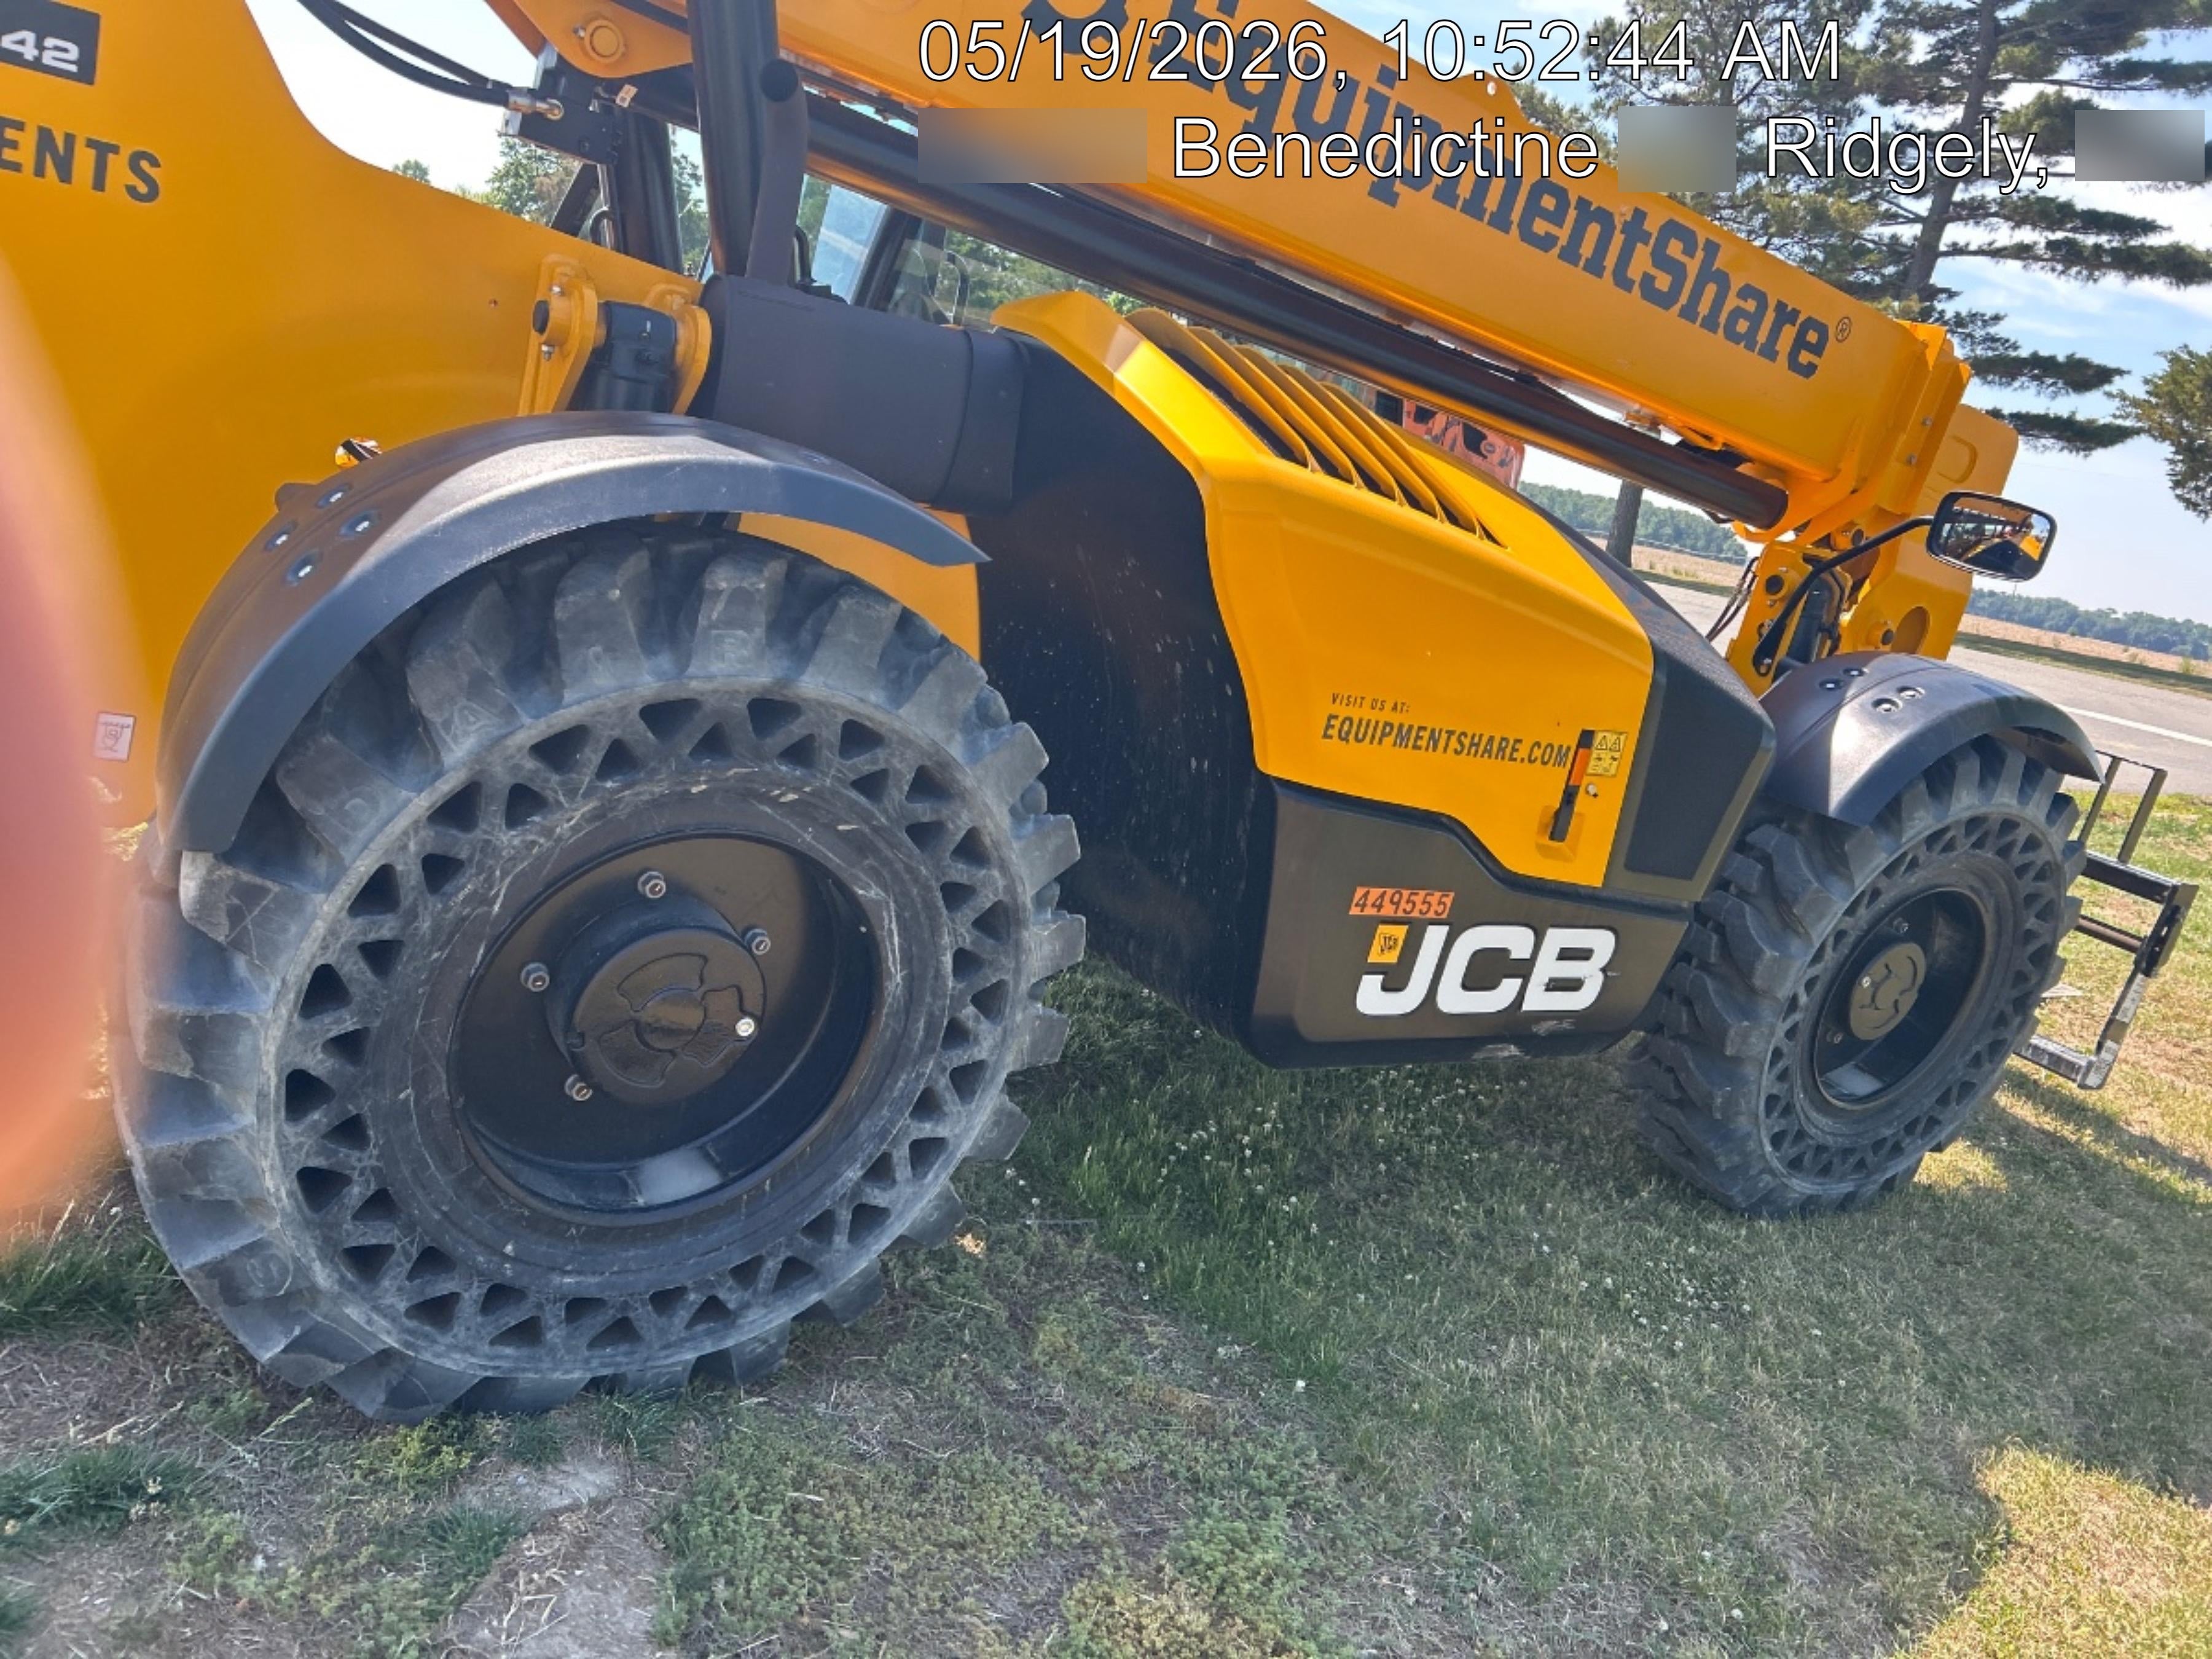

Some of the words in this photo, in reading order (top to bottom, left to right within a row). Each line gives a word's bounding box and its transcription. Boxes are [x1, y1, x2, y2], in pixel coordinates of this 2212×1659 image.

[1331, 692, 1365, 709] VISIT
[1370, 698, 1386, 712] US
[1390, 700, 1411, 713] AT:
[1322, 714, 1569, 767] EQUIPMENTSHARE.COM
[1354, 889, 1450, 917] 449555
[1355, 924, 1617, 1015] JCB
